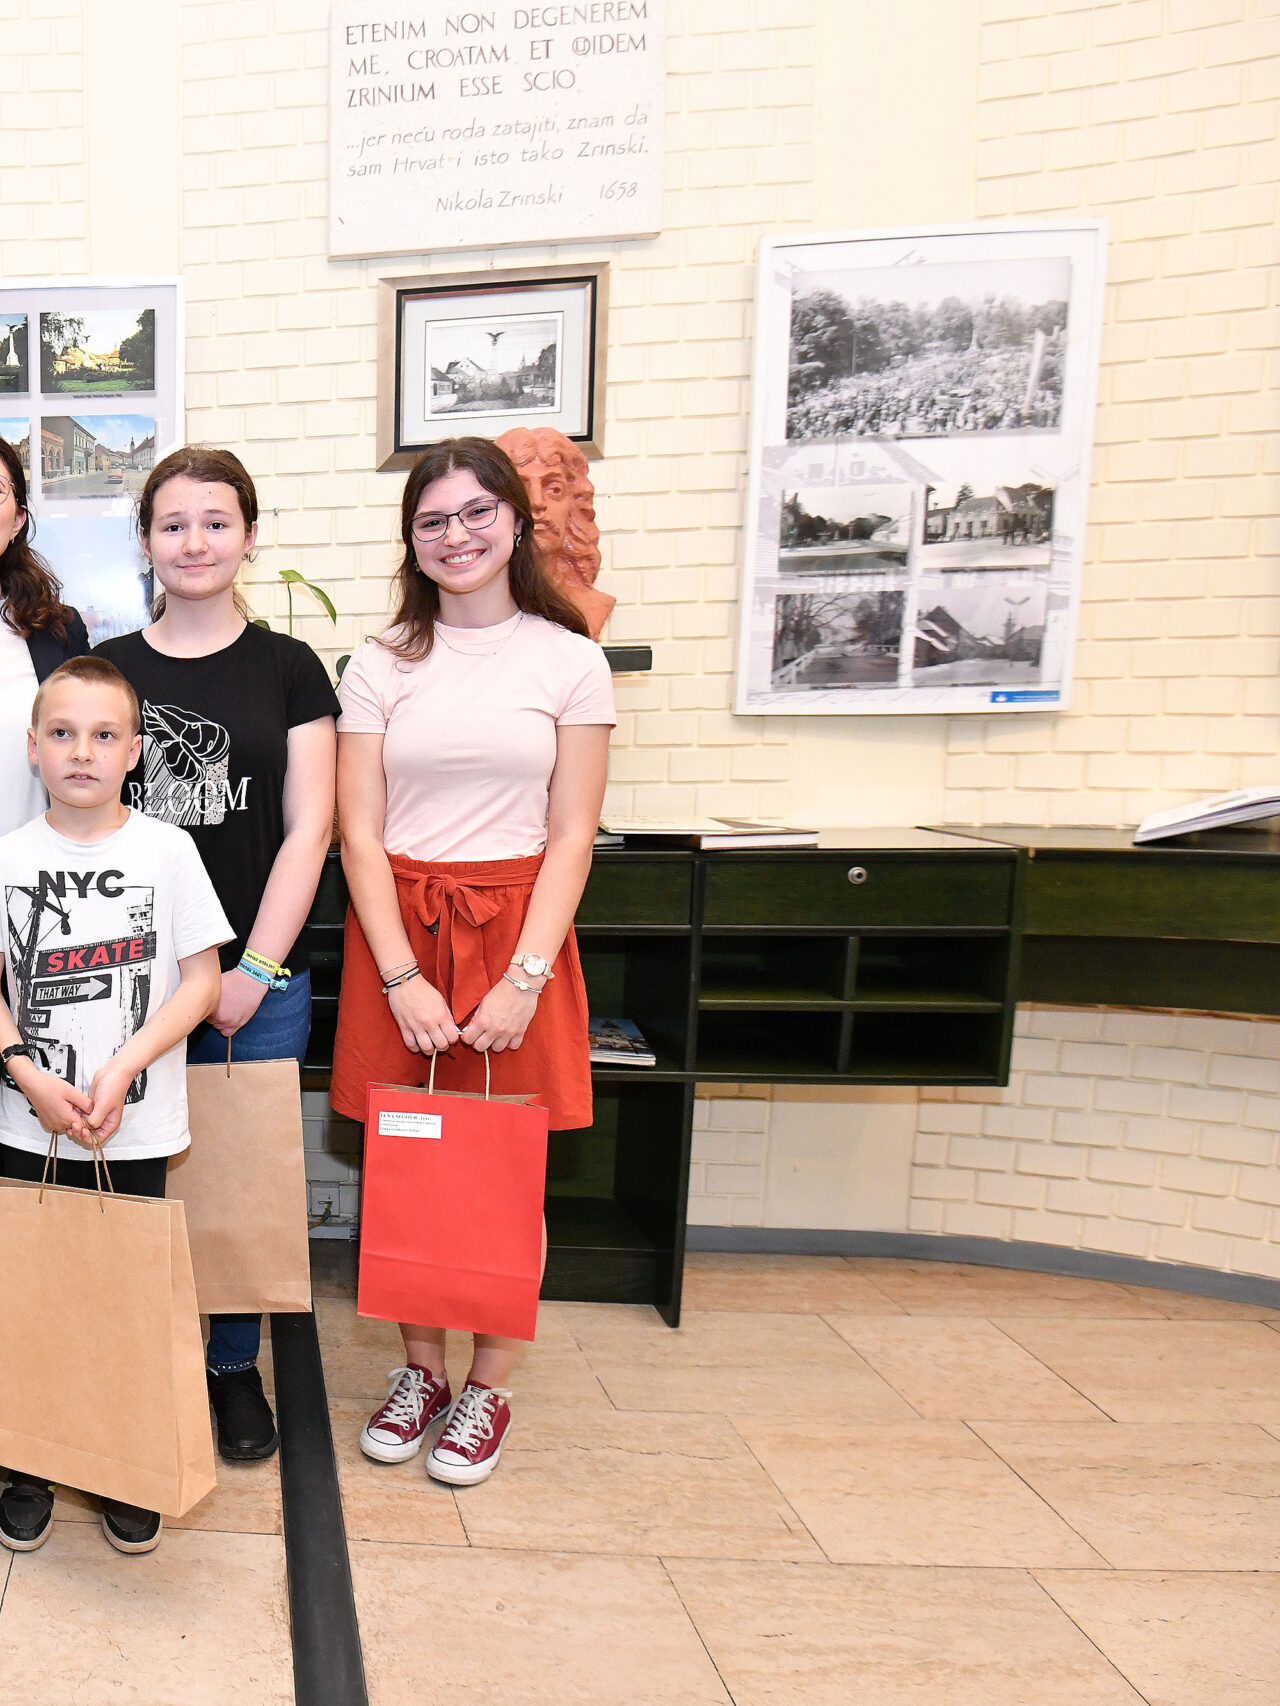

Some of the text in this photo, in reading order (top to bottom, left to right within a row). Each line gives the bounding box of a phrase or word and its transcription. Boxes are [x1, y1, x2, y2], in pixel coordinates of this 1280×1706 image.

[345, 1, 648, 45] ETENIM NON DEGENEREM
[348, 55, 389, 77] ME,
[407, 44, 509, 71] CROATAM
[530, 39, 554, 61] ET
[347, 82, 436, 108] ZRINIUM
[459, 75, 503, 98] ESSE
[391, 126, 435, 145] neću
[442, 117, 485, 141] roda
[491, 118, 560, 144] zatajiti,
[566, 114, 614, 131] znam
[624, 104, 648, 127] da
[347, 163, 382, 177] sam
[393, 153, 445, 174] Hrvat
[474, 149, 509, 168] isto
[520, 141, 564, 163] tako
[435, 181, 639, 213] Nikola Zrinski 1658
[38, 869, 125, 899] NYC
[46, 938, 144, 972] SKATE
[39, 984, 82, 1000] THAT WAY
